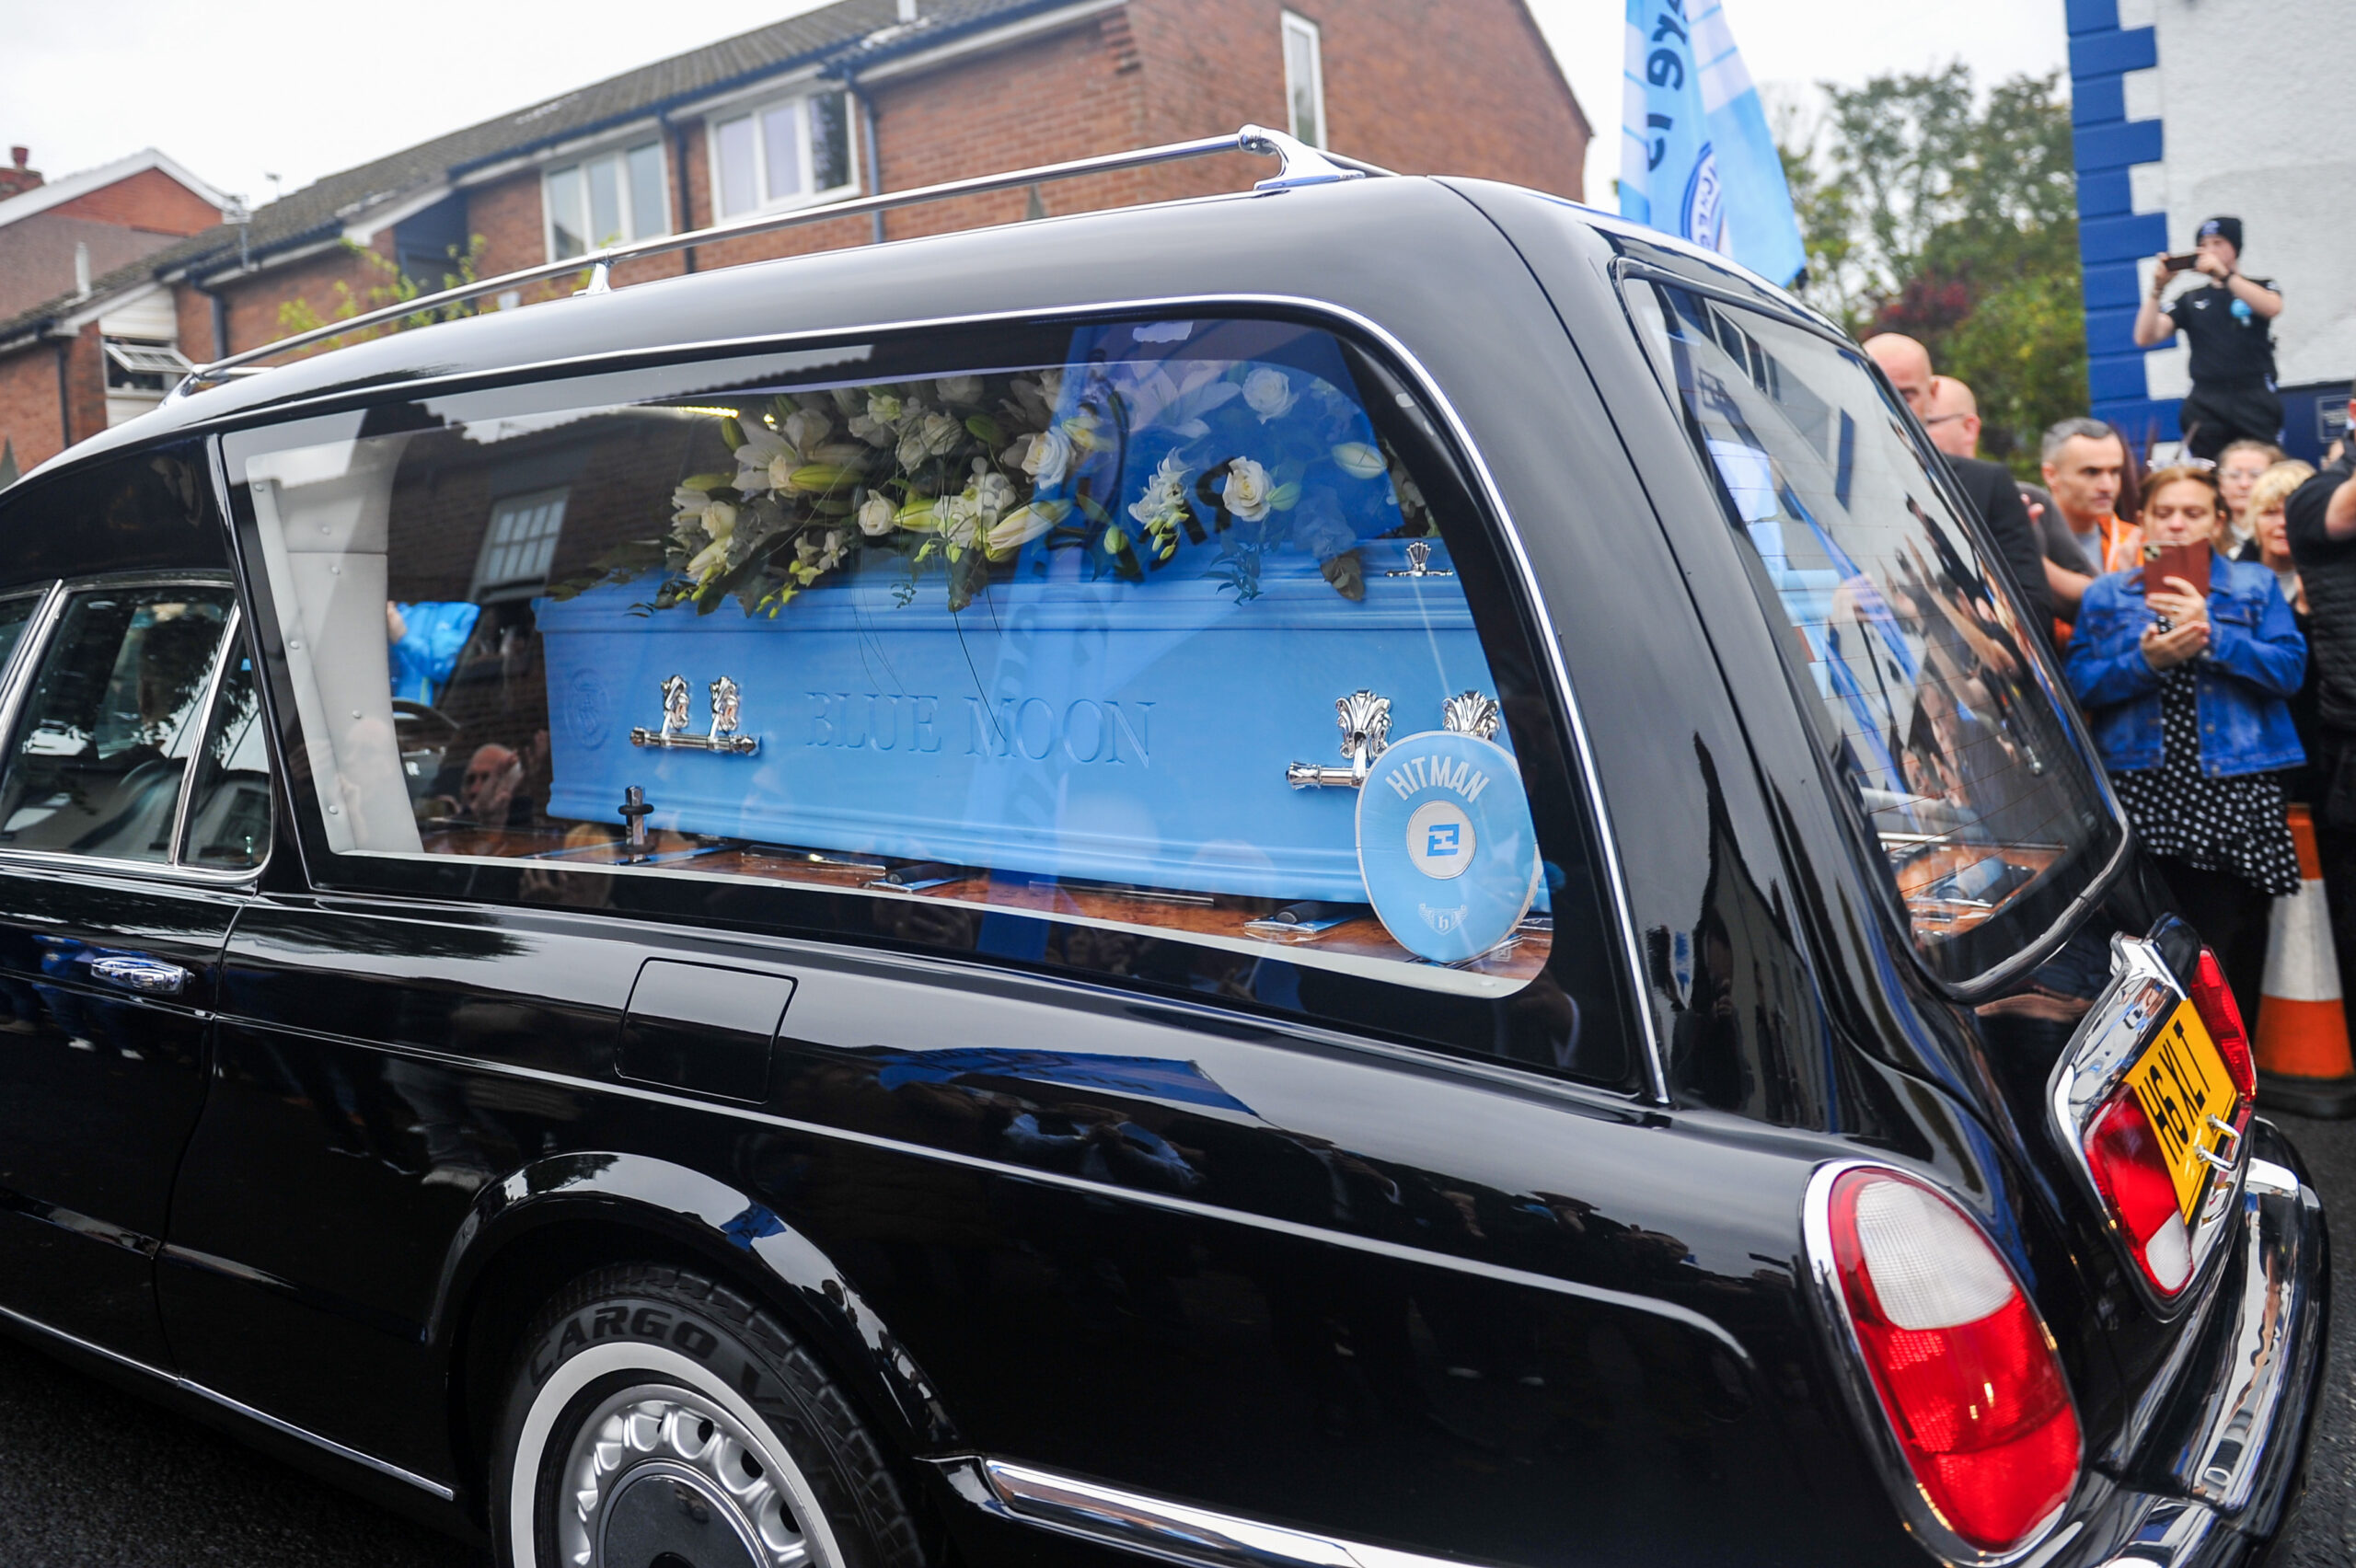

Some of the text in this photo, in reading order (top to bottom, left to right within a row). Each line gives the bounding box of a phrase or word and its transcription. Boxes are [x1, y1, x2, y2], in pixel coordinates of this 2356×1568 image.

[804, 691, 1157, 769] BLUE MOON
[1385, 755, 1490, 803] HITMAN
[2139, 1020, 2211, 1166] H6 XLT
[530, 1305, 719, 1386] CARGO
